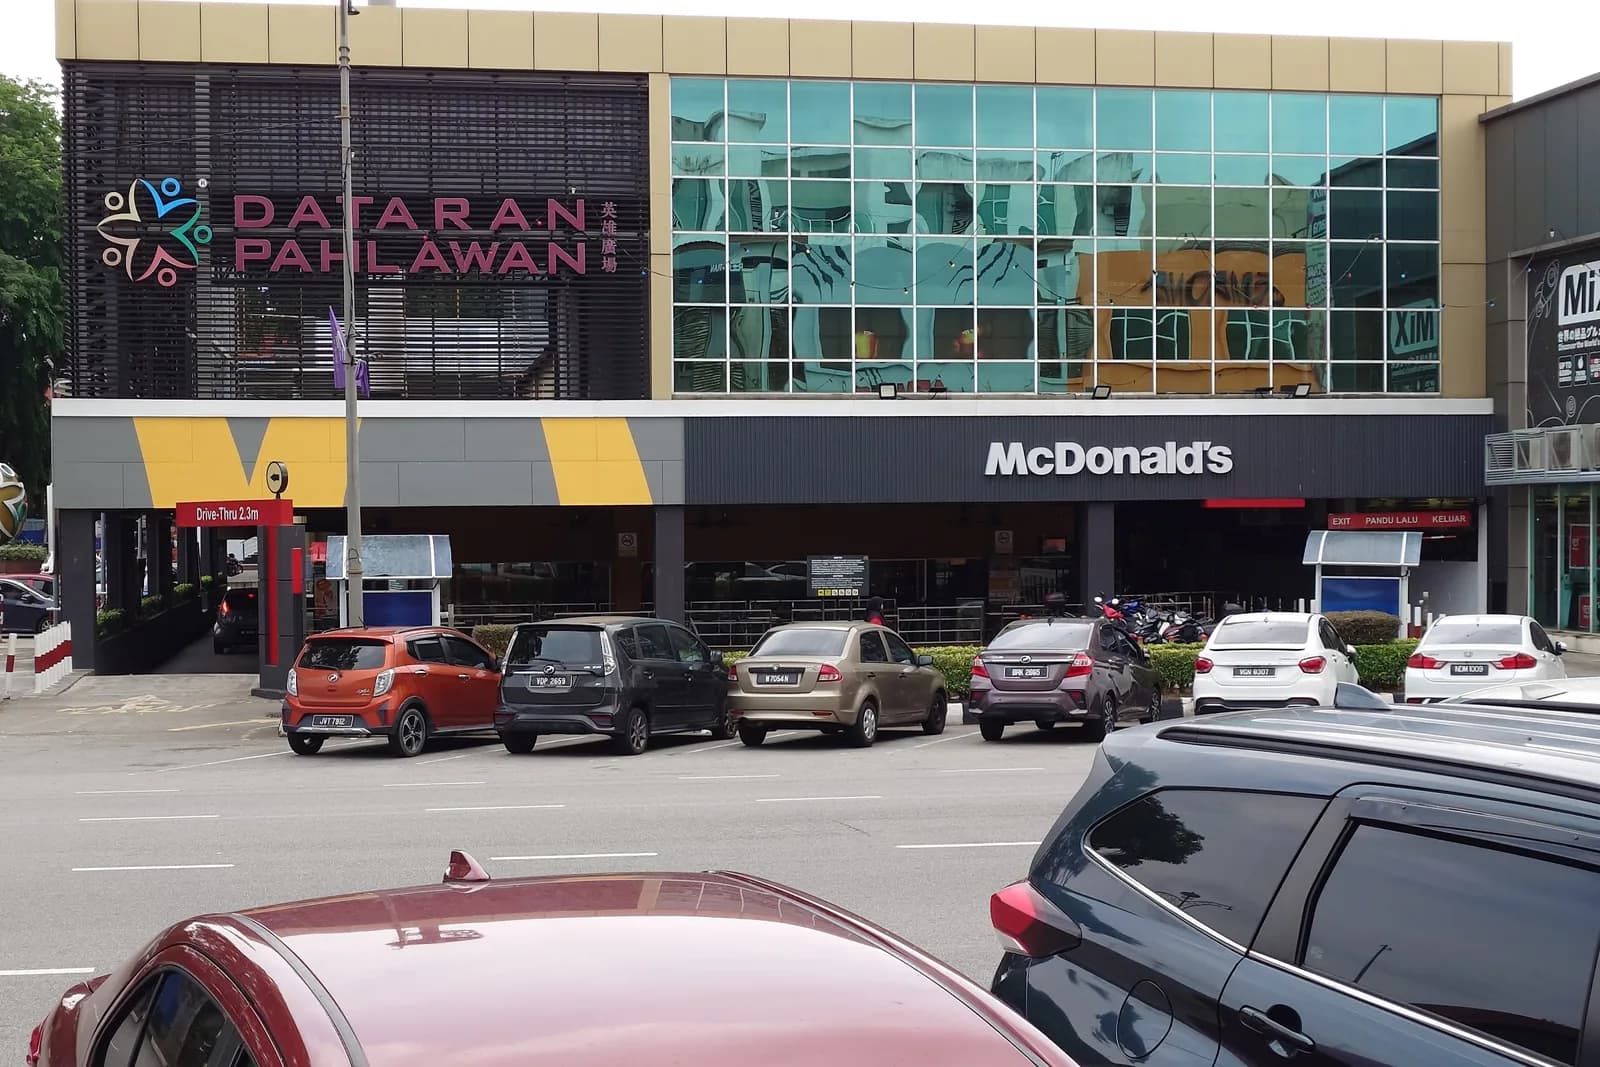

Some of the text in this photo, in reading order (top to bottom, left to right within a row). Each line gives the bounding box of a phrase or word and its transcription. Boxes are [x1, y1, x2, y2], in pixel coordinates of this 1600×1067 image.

[234, 195, 586, 231] DATARAN
[235, 239, 587, 275] PAHLAWAN
[1564, 267, 1600, 317] Mi
[984, 441, 1233, 475] McDonald's
[196, 506, 259, 521] Drive-Thru 2.3m
[1332, 514, 1466, 526] EXIT PANDU LALU KELUAR
